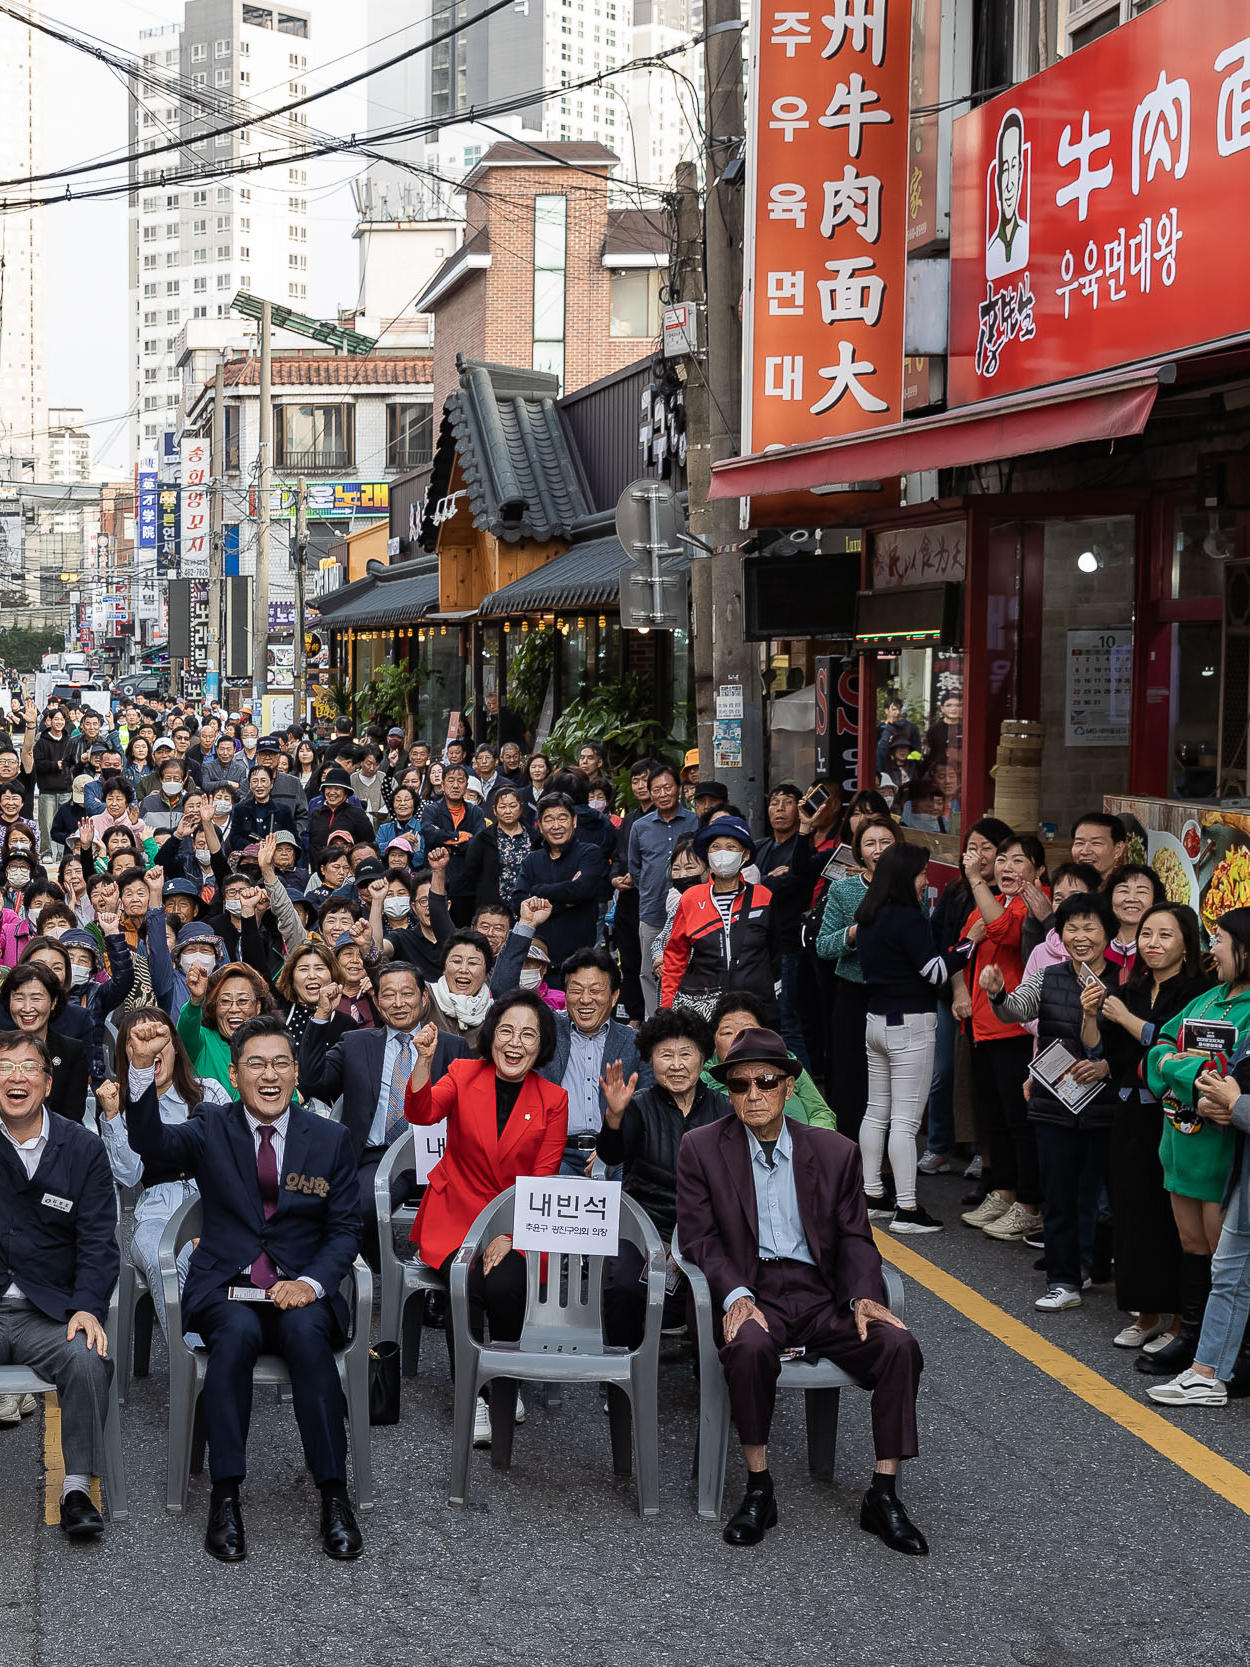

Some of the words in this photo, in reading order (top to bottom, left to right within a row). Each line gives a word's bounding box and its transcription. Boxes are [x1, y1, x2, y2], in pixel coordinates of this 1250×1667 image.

[764, 12, 811, 401] 주우육면대
[810, 0, 892, 413] 州牛肉面大
[1056, 207, 1183, 320] 우육면대왕
[1098, 635, 1116, 649] 10
[525, 1222, 549, 1233] 추윤구
[551, 1224, 589, 1236] 광진구의회
[592, 1227, 608, 1237] 의장
[529, 1191, 607, 1221] 내빈석
